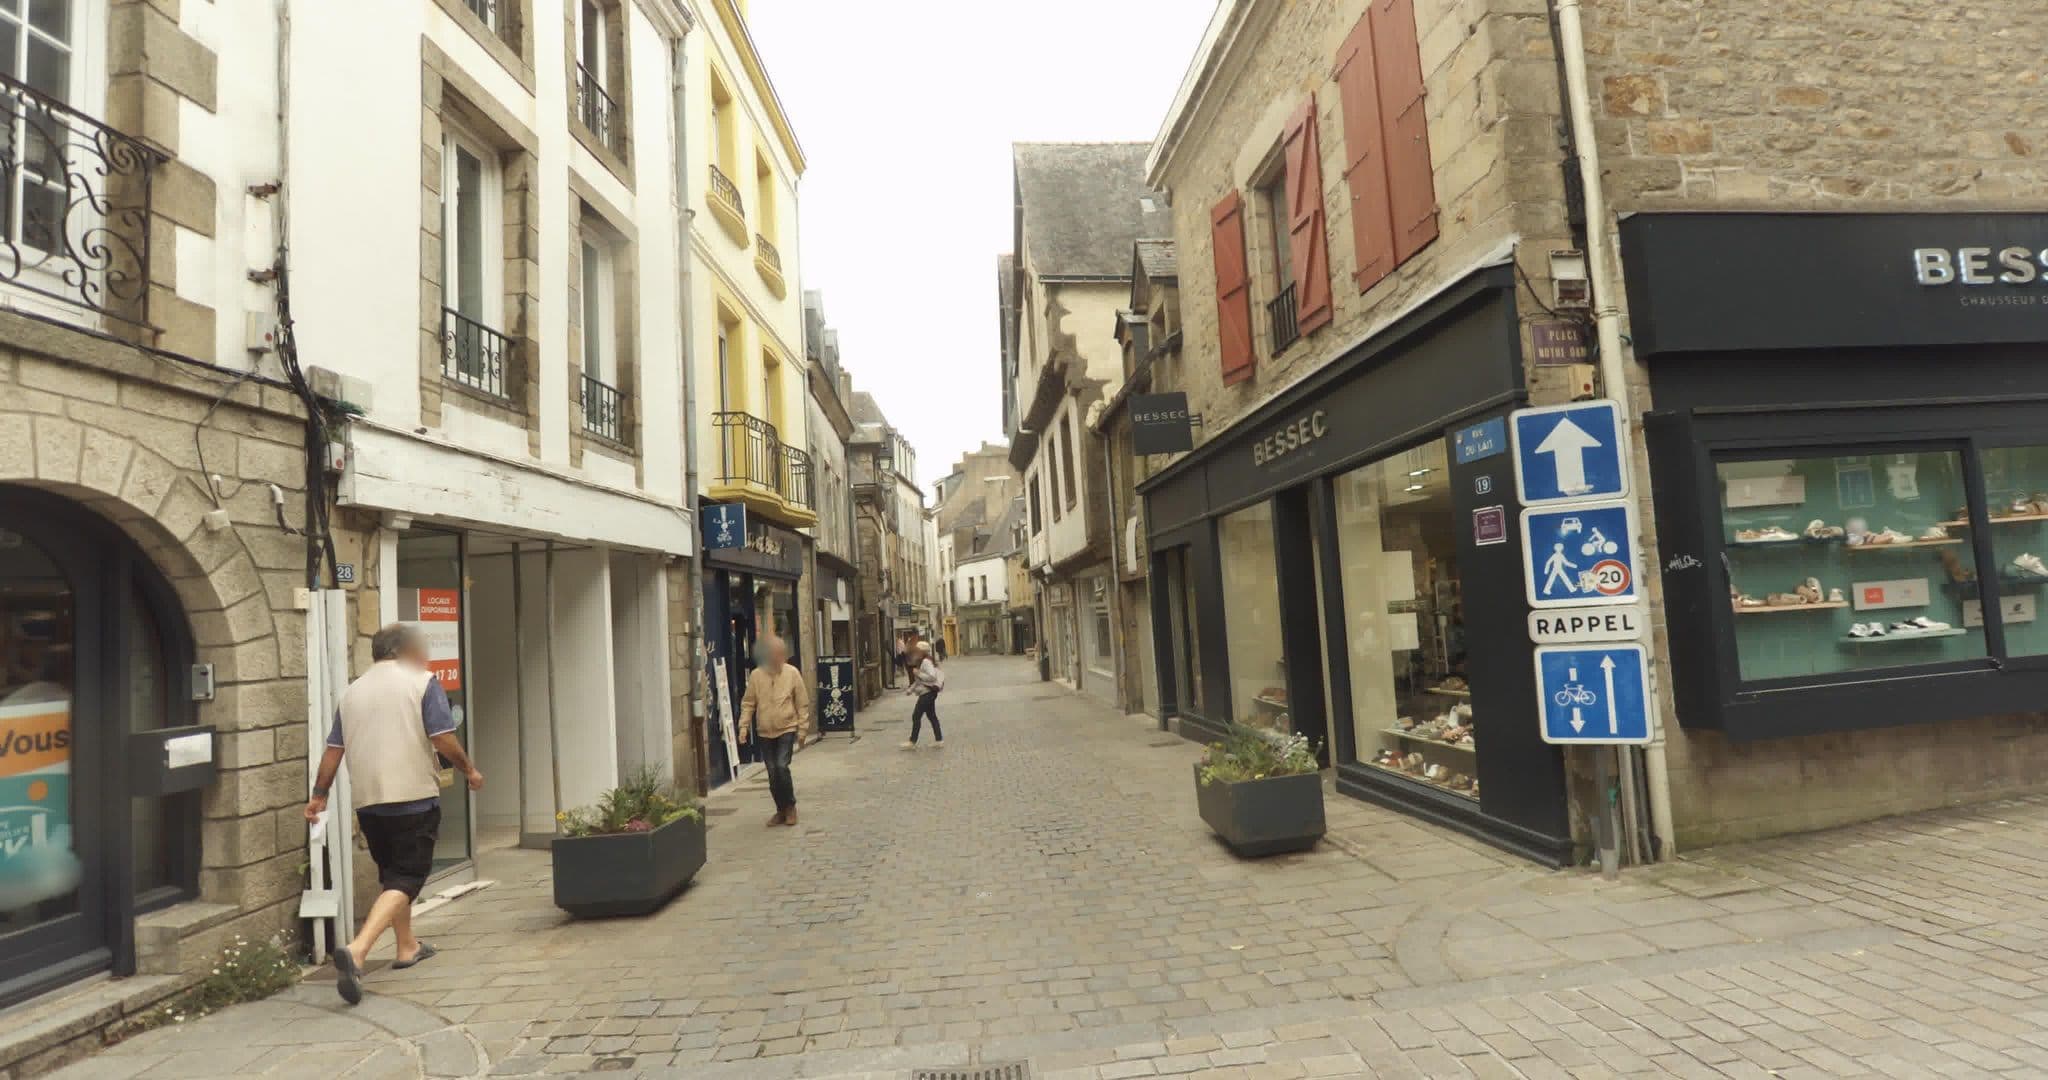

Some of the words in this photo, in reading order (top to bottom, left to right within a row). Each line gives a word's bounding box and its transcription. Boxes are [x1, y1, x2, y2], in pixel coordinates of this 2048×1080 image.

[1914, 246, 2048, 285] BES
[1960, 295, 2036, 306] CHAUSSEUR
[1549, 329, 1577, 341] PLACE
[1134, 410, 1185, 422] BESSEC
[1253, 410, 1326, 466] BESSEC
[1465, 445, 1475, 456] DU
[1477, 438, 1493, 452] LAIT
[1477, 479, 1489, 492] 19
[337, 566, 351, 579] 28
[1599, 570, 1621, 584] 20
[420, 606, 457, 614] DISPONIBLES
[1536, 614, 1635, 635] RAPPEL
